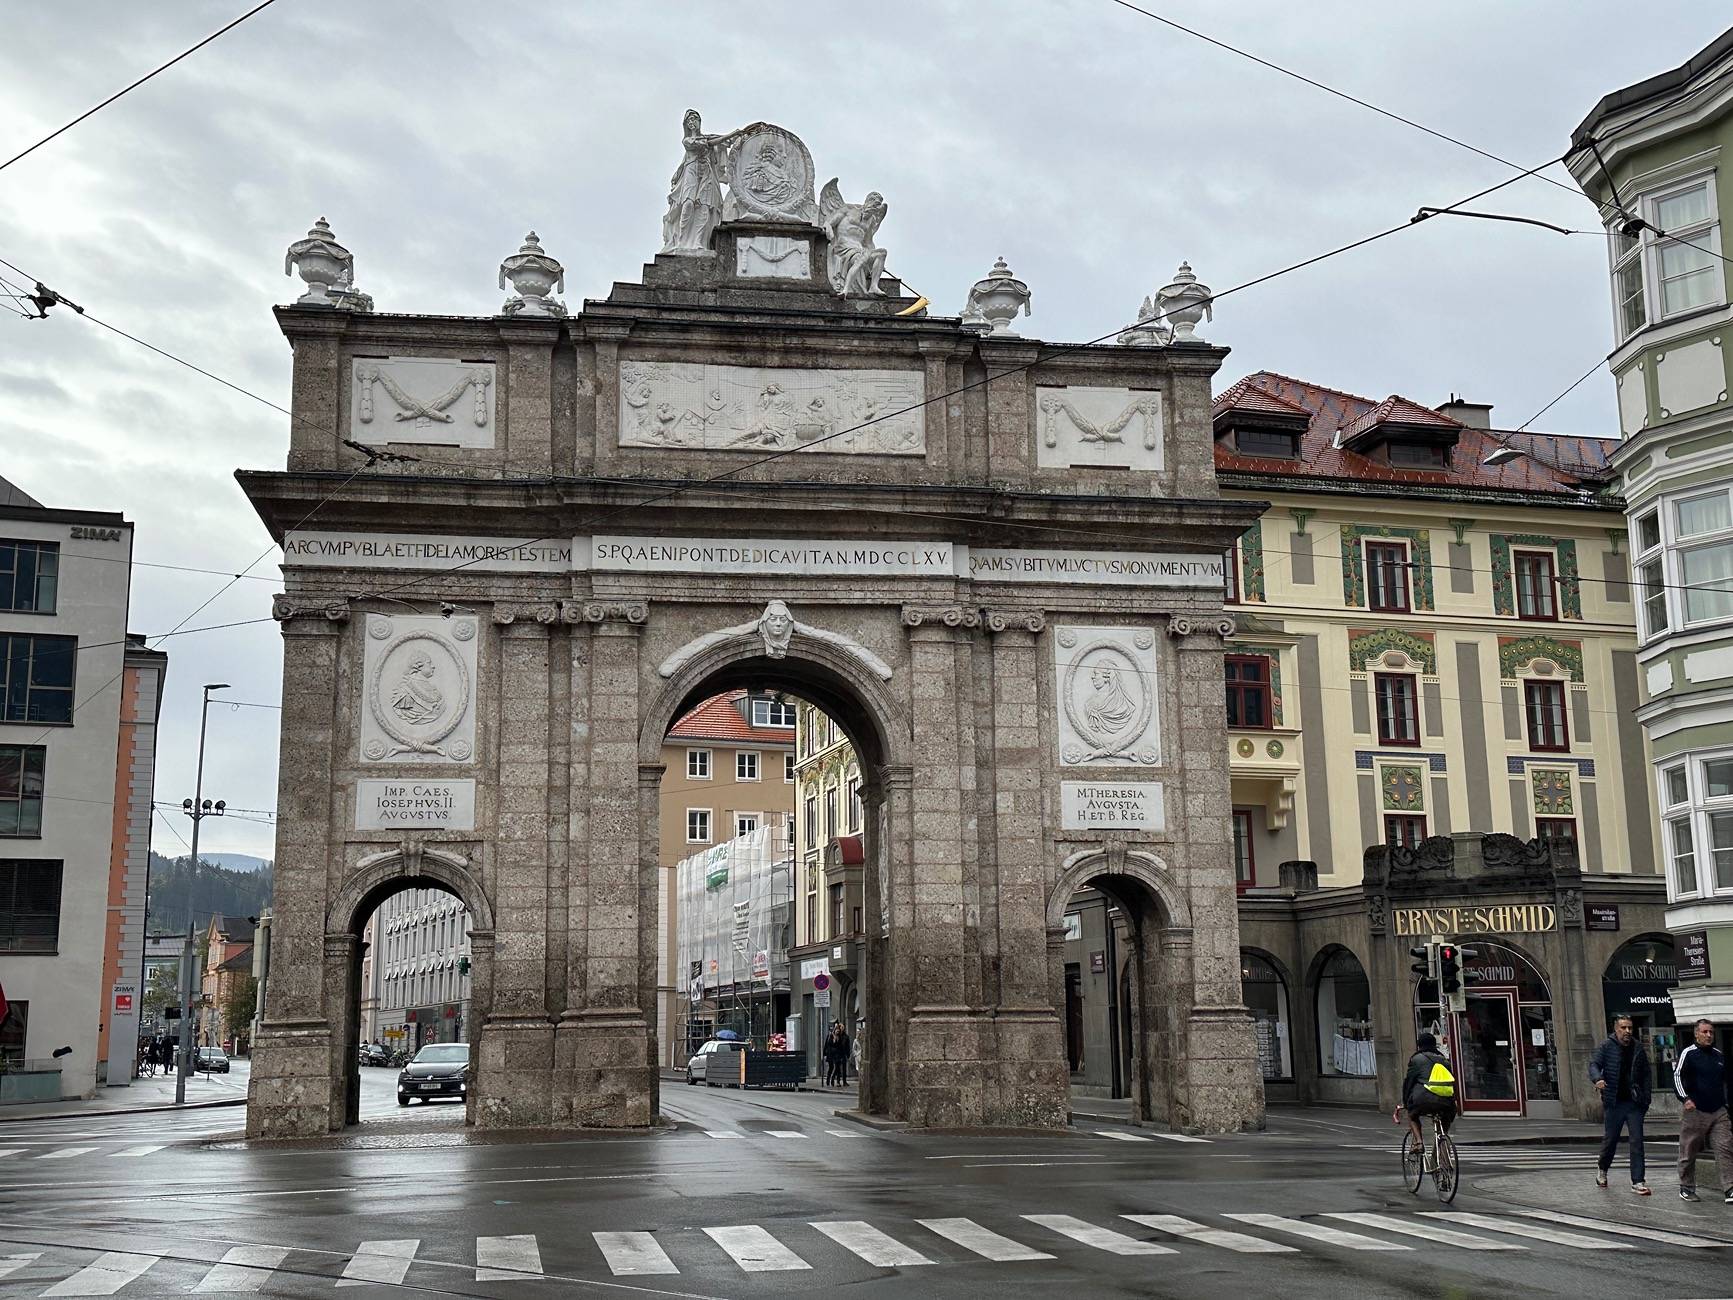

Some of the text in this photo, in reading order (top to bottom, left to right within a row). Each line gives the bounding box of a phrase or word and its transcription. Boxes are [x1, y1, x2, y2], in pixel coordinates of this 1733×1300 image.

[70, 526, 122, 542] ZIMA
[1394, 905, 1555, 934] ERNST SCHMID
[1622, 964, 1647, 979] ERNST
[1630, 996, 1671, 1004] MONTBLANC
